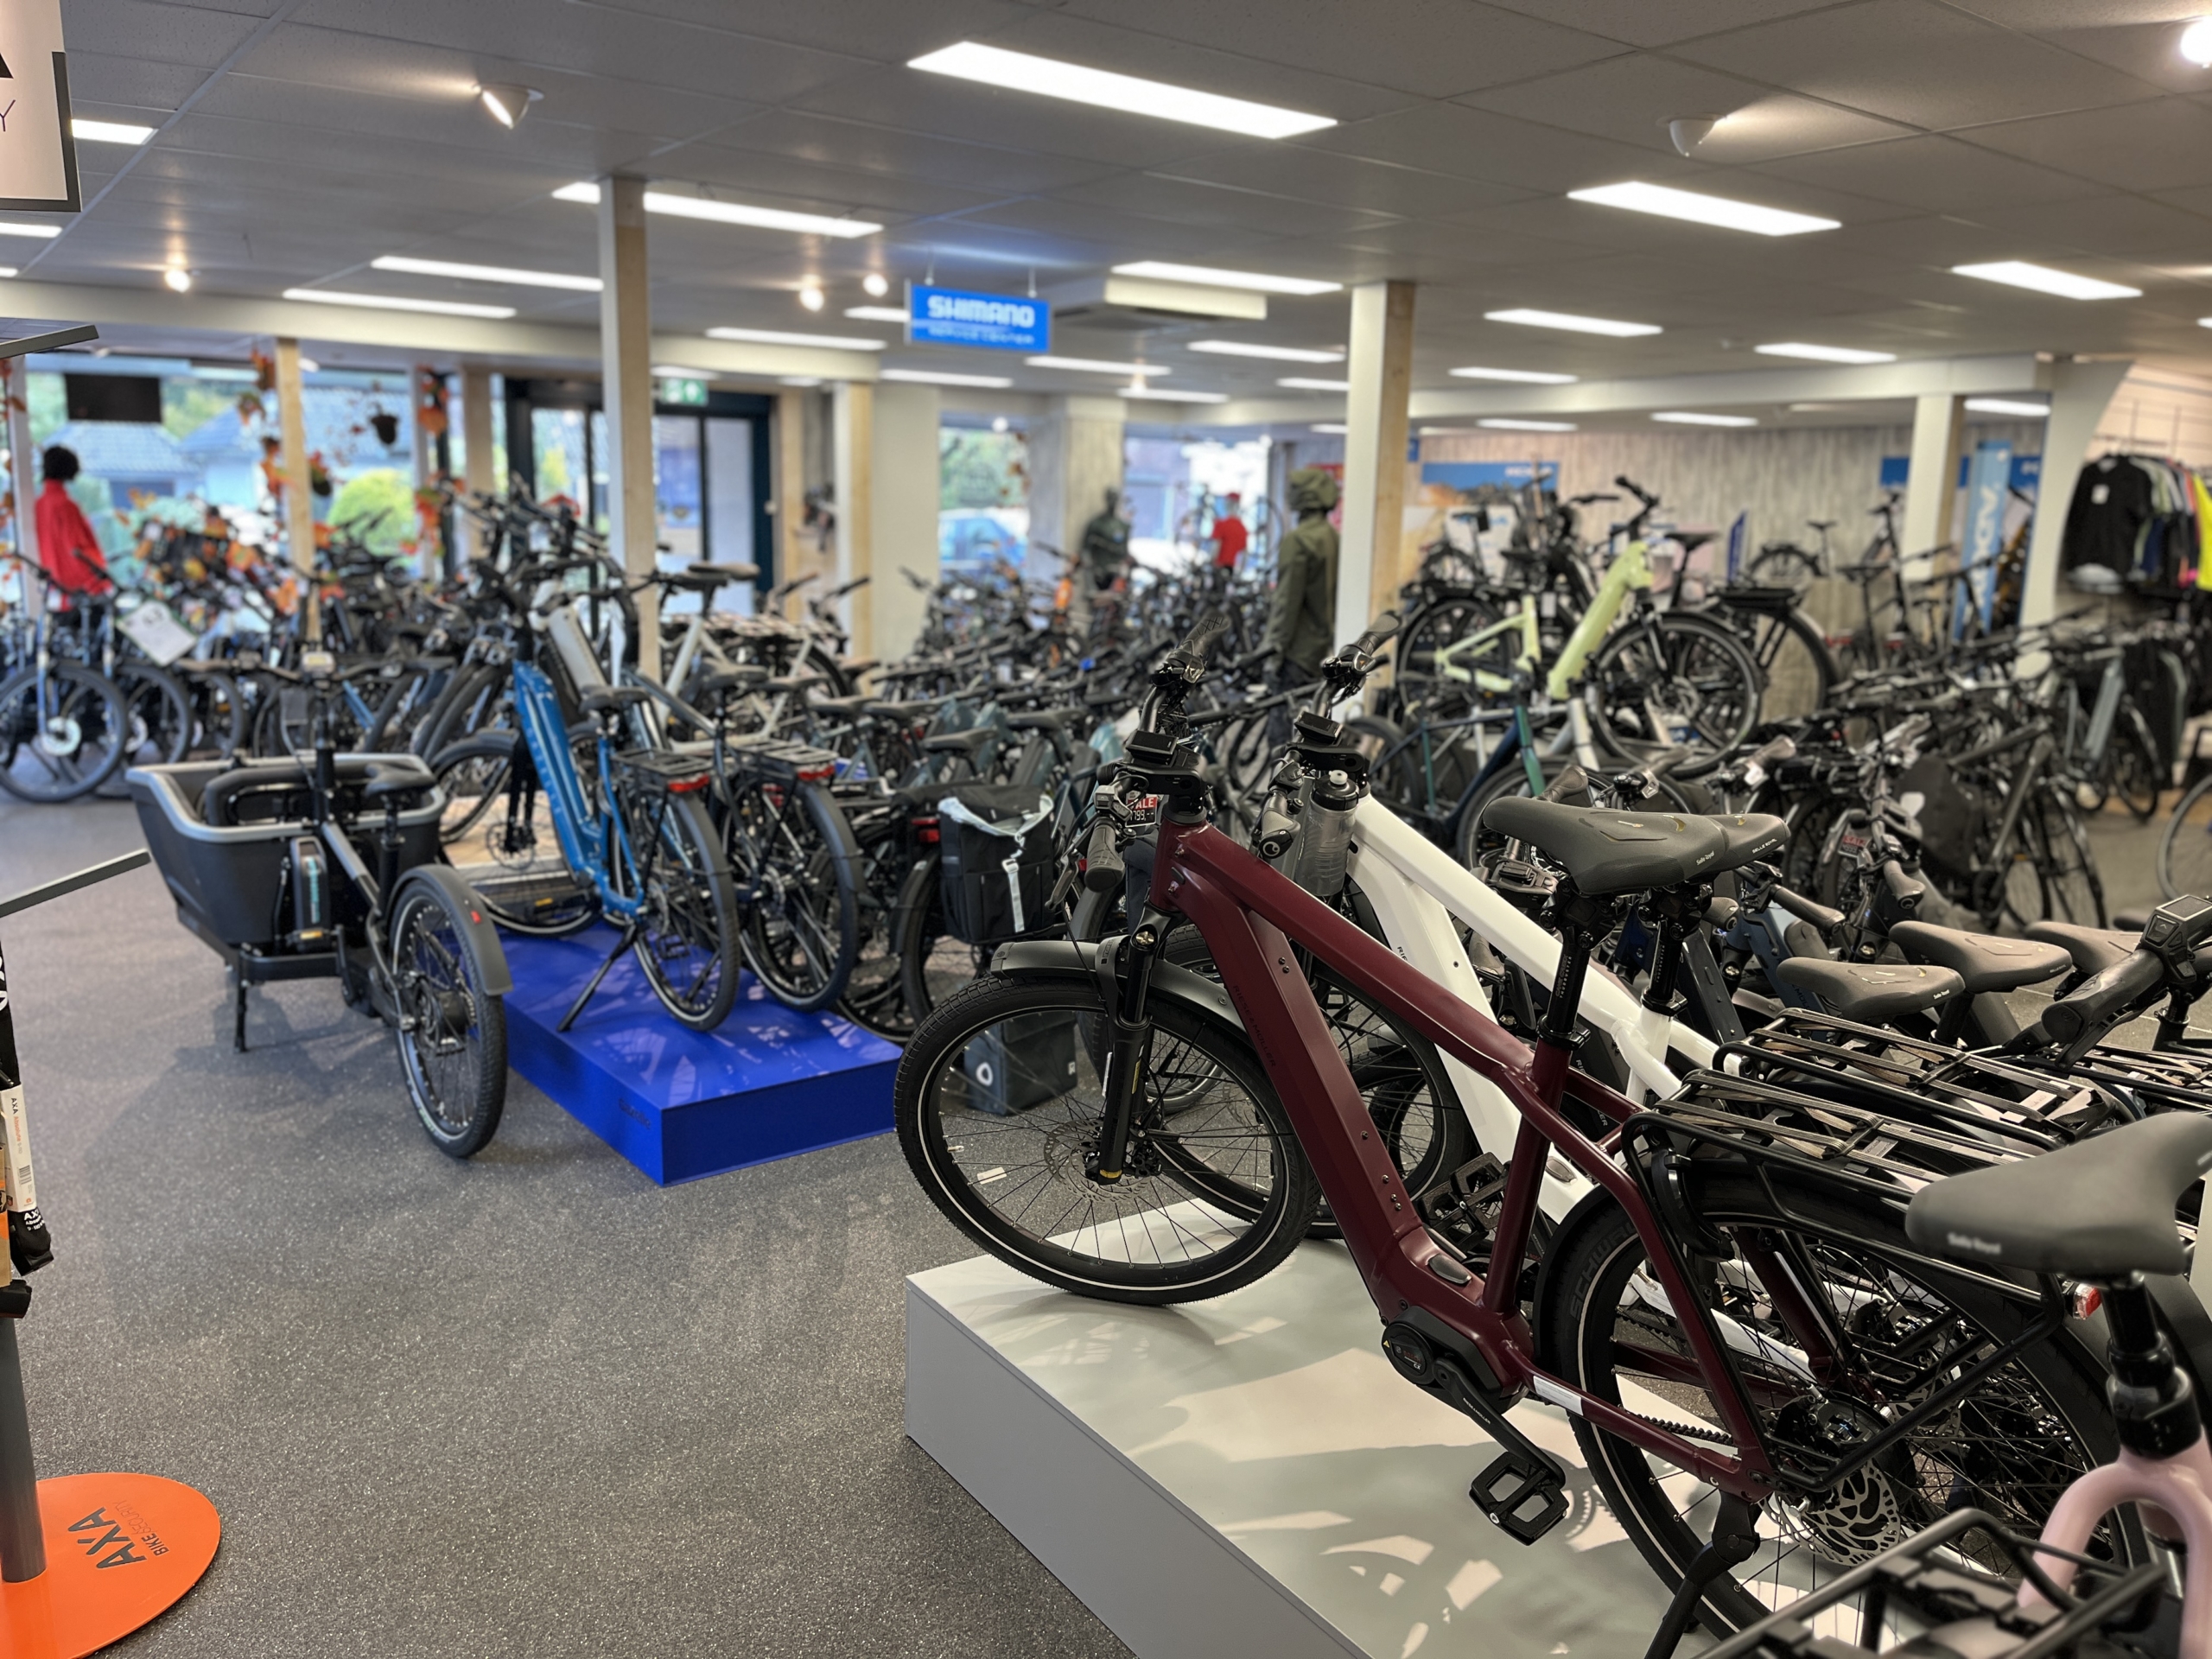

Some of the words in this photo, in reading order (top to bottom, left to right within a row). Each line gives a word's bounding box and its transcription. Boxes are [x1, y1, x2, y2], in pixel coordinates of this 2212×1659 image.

[927, 294, 1036, 329] SHIMANO
[1131, 798, 1154, 810] ALE
[1570, 1221, 1637, 1322] SCHWAL
[67, 1506, 147, 1569] AXA
[141, 1533, 169, 1556] BIKE
